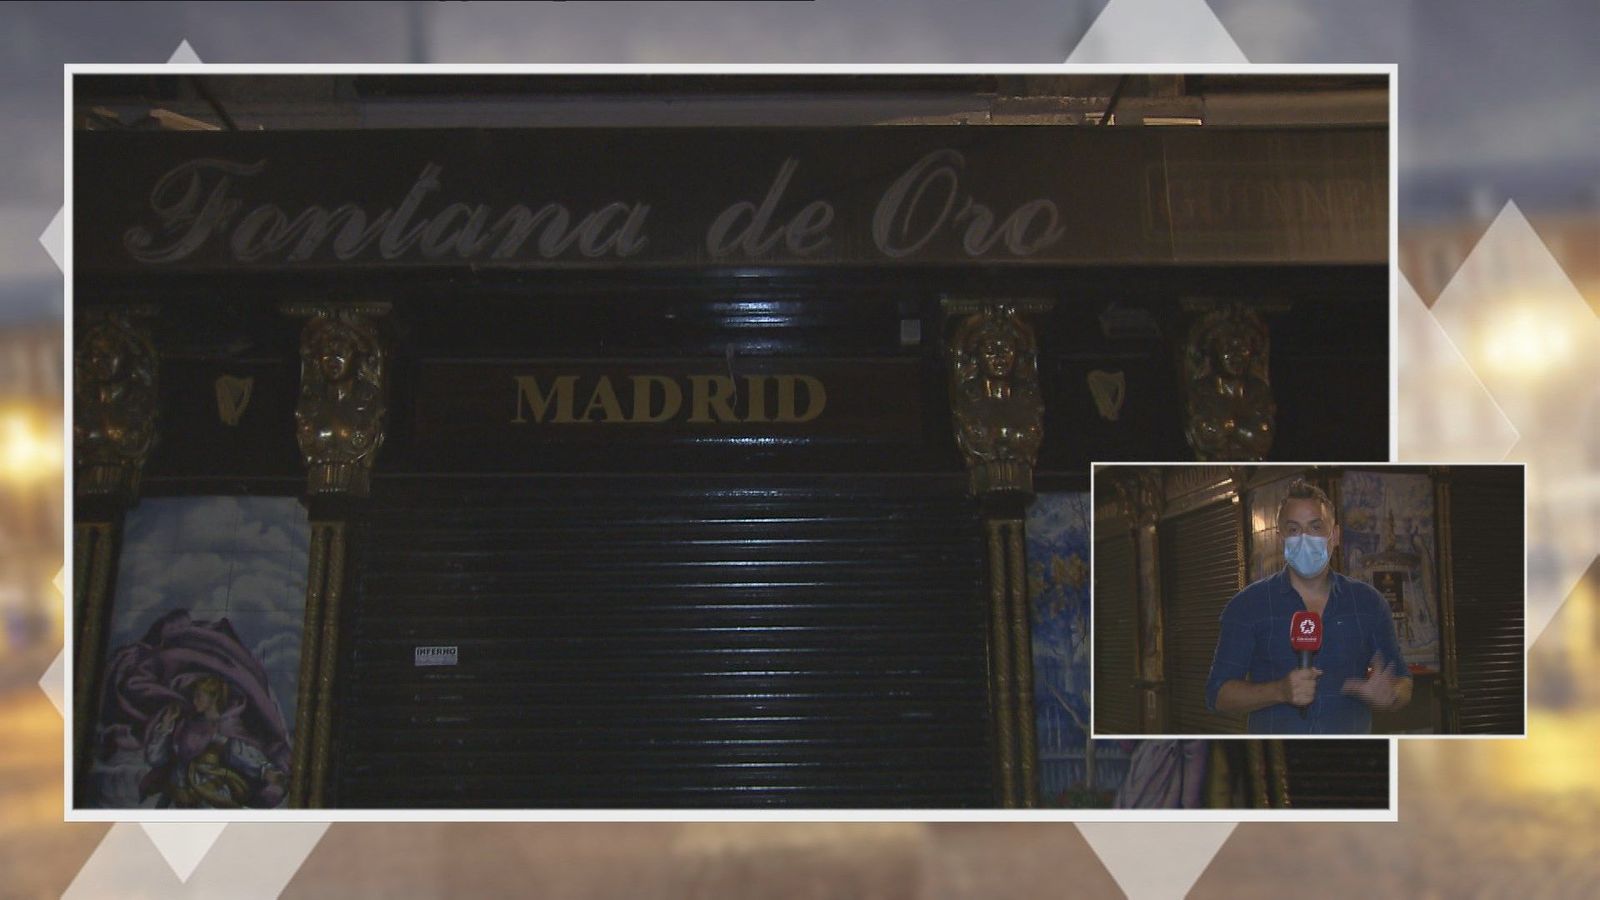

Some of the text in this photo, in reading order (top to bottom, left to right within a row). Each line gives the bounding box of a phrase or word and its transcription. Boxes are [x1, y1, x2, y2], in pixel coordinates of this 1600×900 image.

[122, 149, 1067, 263] Fontana de Oro
[510, 374, 828, 424] MADRID
[416, 647, 457, 656] INFERNO
